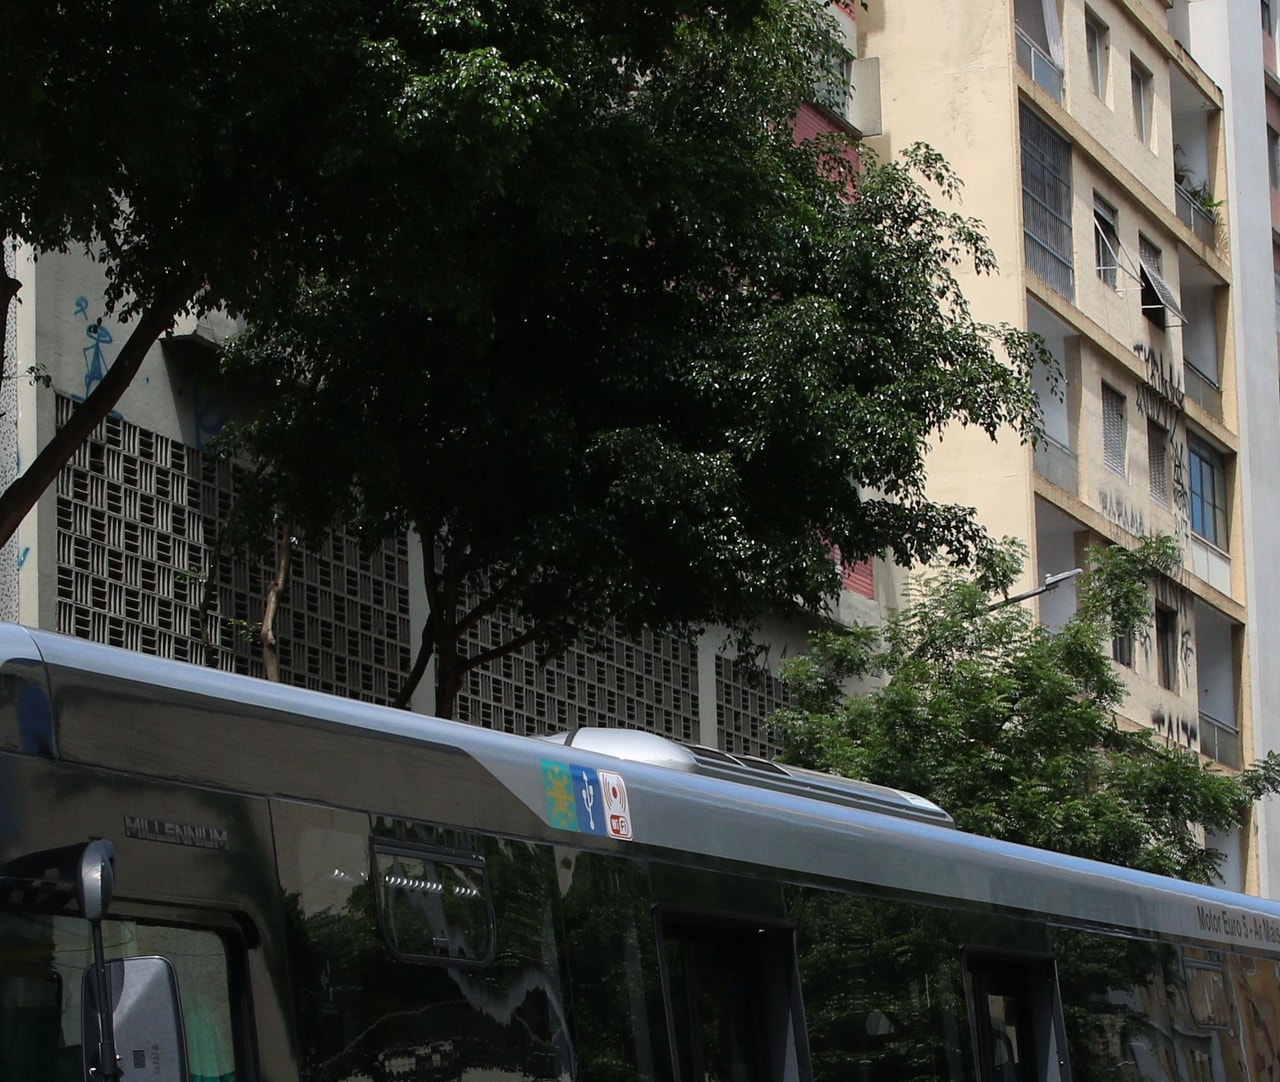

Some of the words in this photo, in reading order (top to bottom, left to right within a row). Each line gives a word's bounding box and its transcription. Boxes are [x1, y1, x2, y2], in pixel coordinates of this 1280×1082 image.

[124, 815, 229, 850] MILLENNIUM
[1196, 905, 1220, 932] Motor
[1222, 911, 1241, 937] Euro
[1242, 915, 1249, 938] 5
[1263, 918, 1280, 944] Mais
